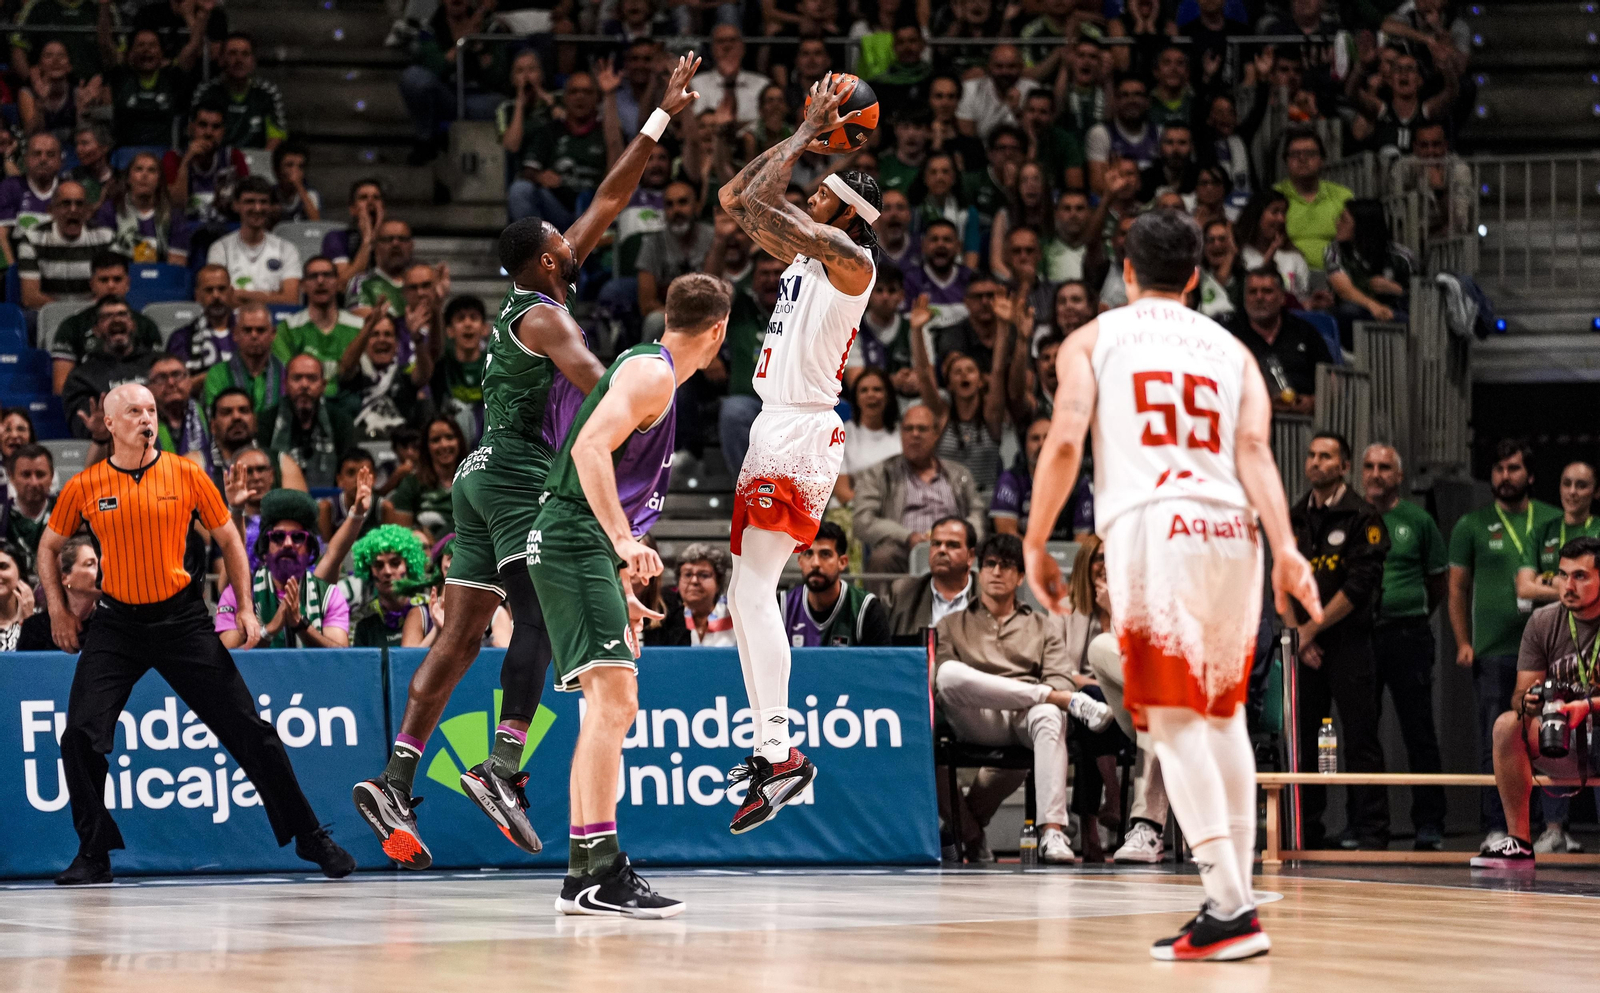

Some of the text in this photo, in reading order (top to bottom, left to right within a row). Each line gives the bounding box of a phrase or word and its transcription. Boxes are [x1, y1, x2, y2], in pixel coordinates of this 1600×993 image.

[777, 275, 802, 301] AXI
[1132, 371, 1221, 455] 55
[20, 693, 358, 752] Fndaión
[578, 694, 903, 748] undaión
[24, 753, 265, 824] Uicaja
